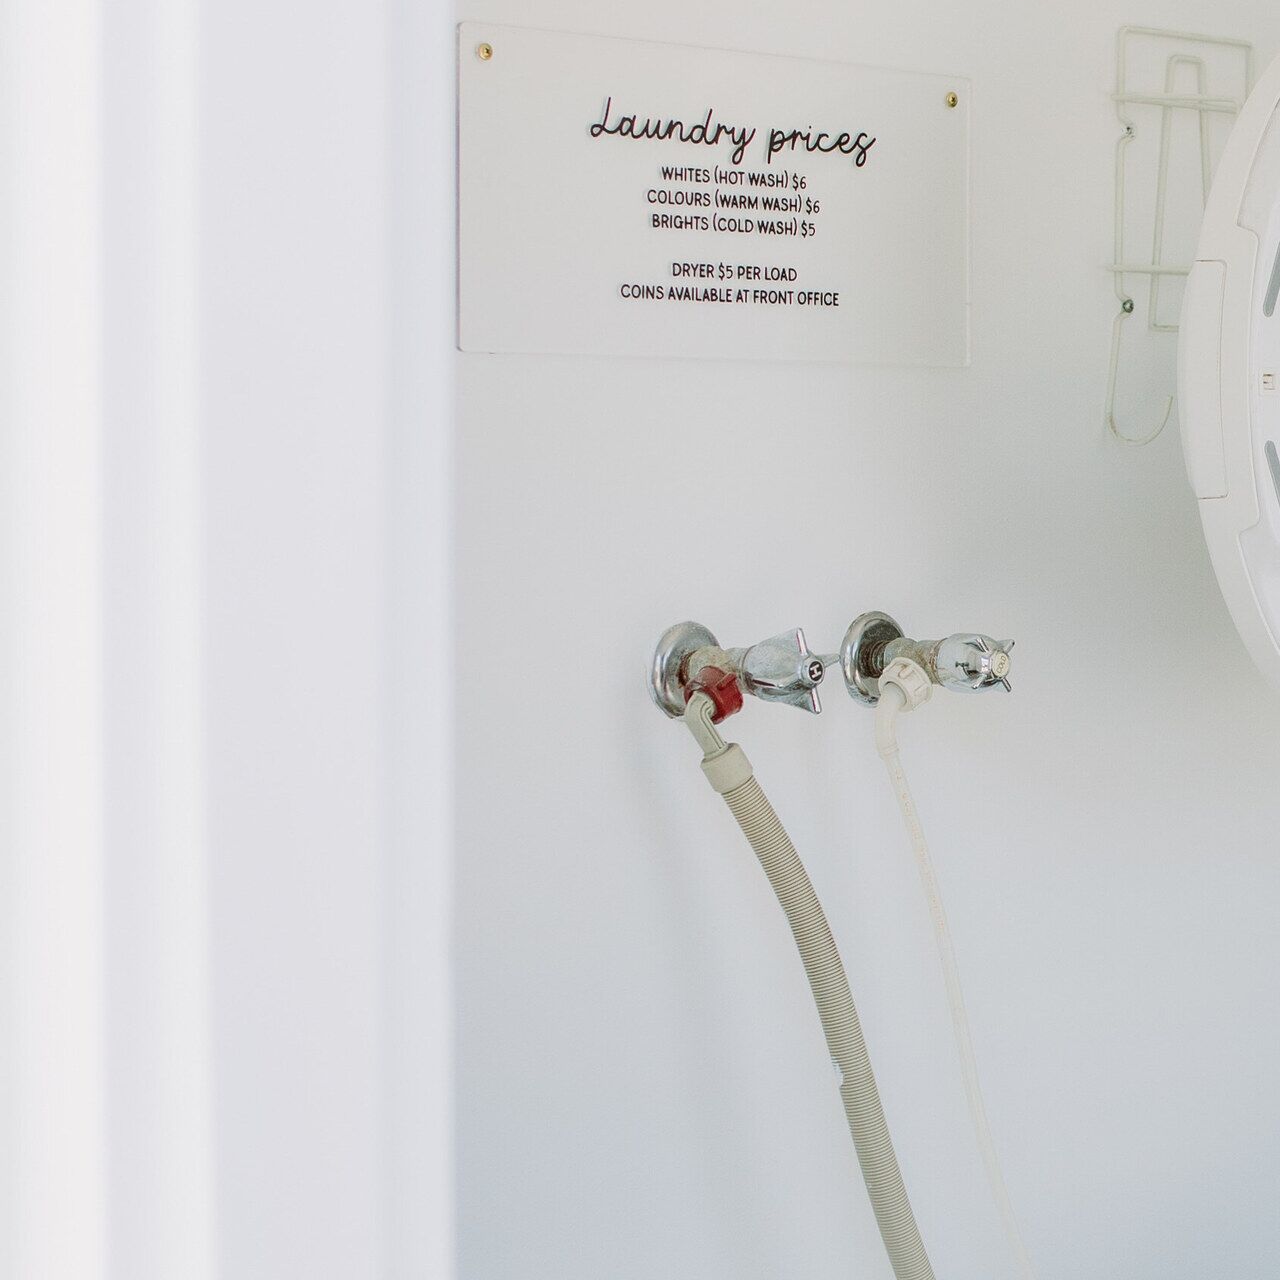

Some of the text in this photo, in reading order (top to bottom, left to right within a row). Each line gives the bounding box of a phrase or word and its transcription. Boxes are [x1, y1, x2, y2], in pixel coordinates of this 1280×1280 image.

[590, 97, 876, 167] Laundry prices
[662, 165, 807, 191] WHITES (HOT WASH) $6
[647, 189, 820, 215] COLOURS (WARM WASH) $6
[652, 212, 816, 238] BRIGHTS (COLD WASH) $5
[672, 262, 798, 282] DRYER $5 PER LOAD
[620, 284, 840, 307] COINS AVAILABLE AT FRONT OFFICE
